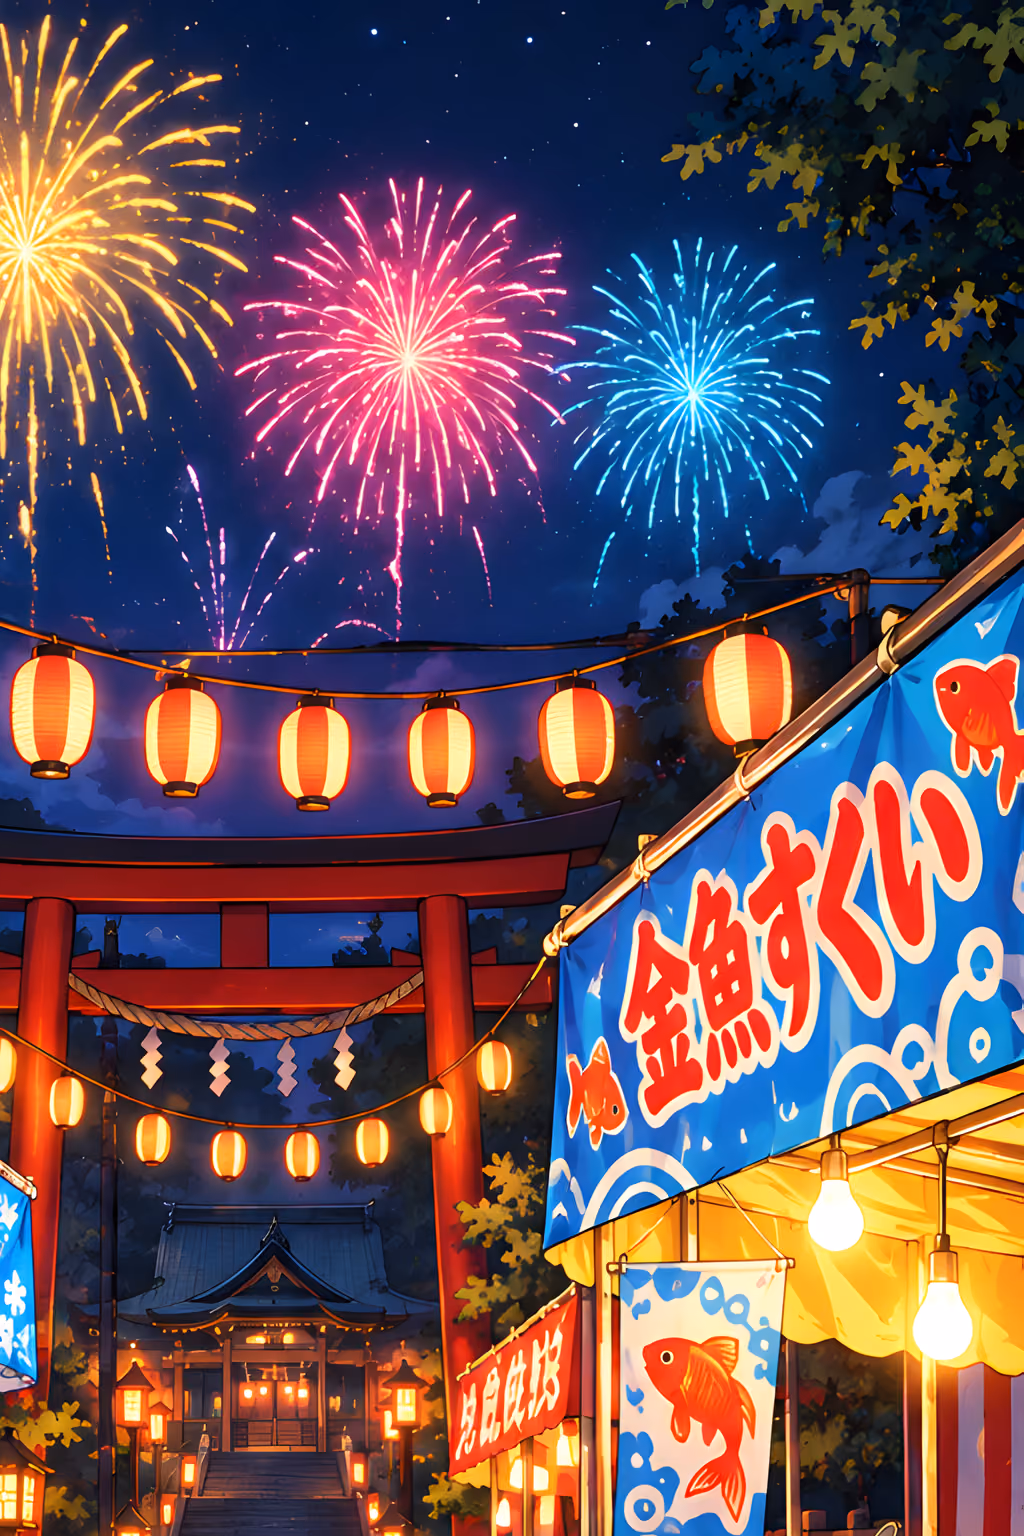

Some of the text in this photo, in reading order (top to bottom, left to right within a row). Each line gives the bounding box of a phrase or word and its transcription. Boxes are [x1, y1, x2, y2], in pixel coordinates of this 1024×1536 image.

[622, 776, 972, 1117] 金魚すくい
